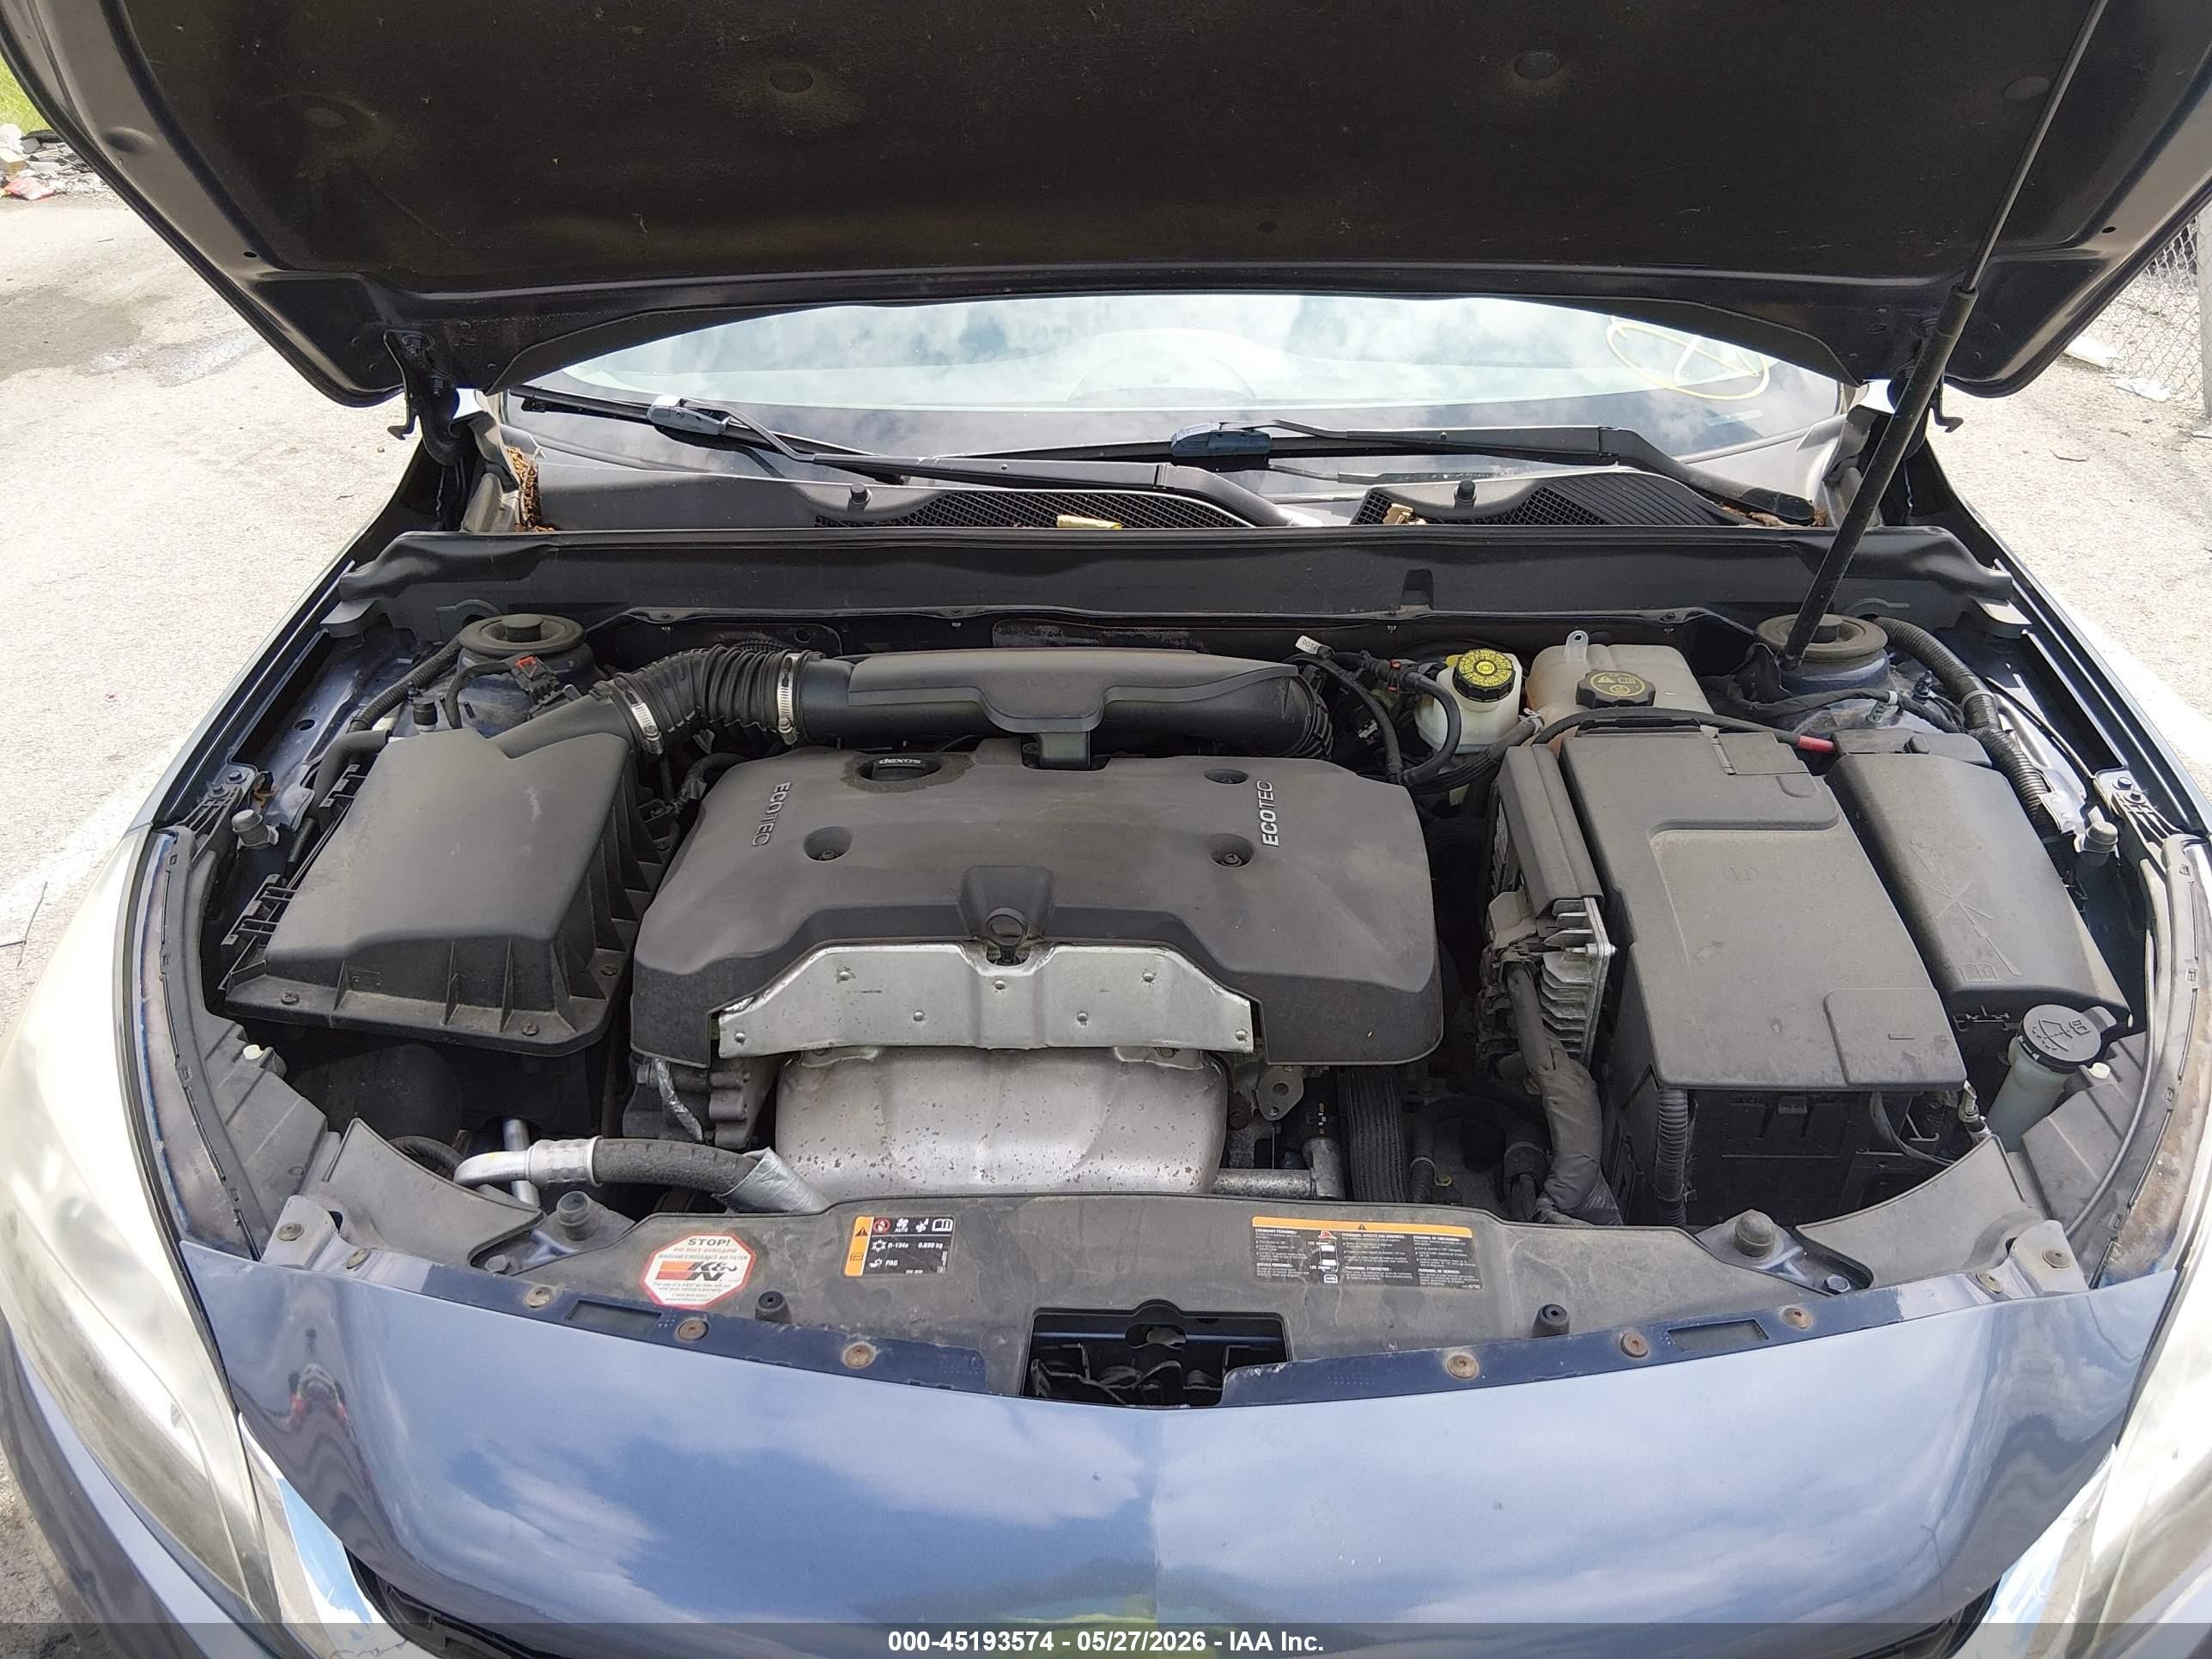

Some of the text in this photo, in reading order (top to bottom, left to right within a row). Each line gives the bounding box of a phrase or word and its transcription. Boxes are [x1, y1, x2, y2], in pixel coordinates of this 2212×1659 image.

[752, 781, 791, 847] ECOTEC
[1256, 780, 1279, 847] ECOTEC
[688, 1238, 731, 1247] STOP!
